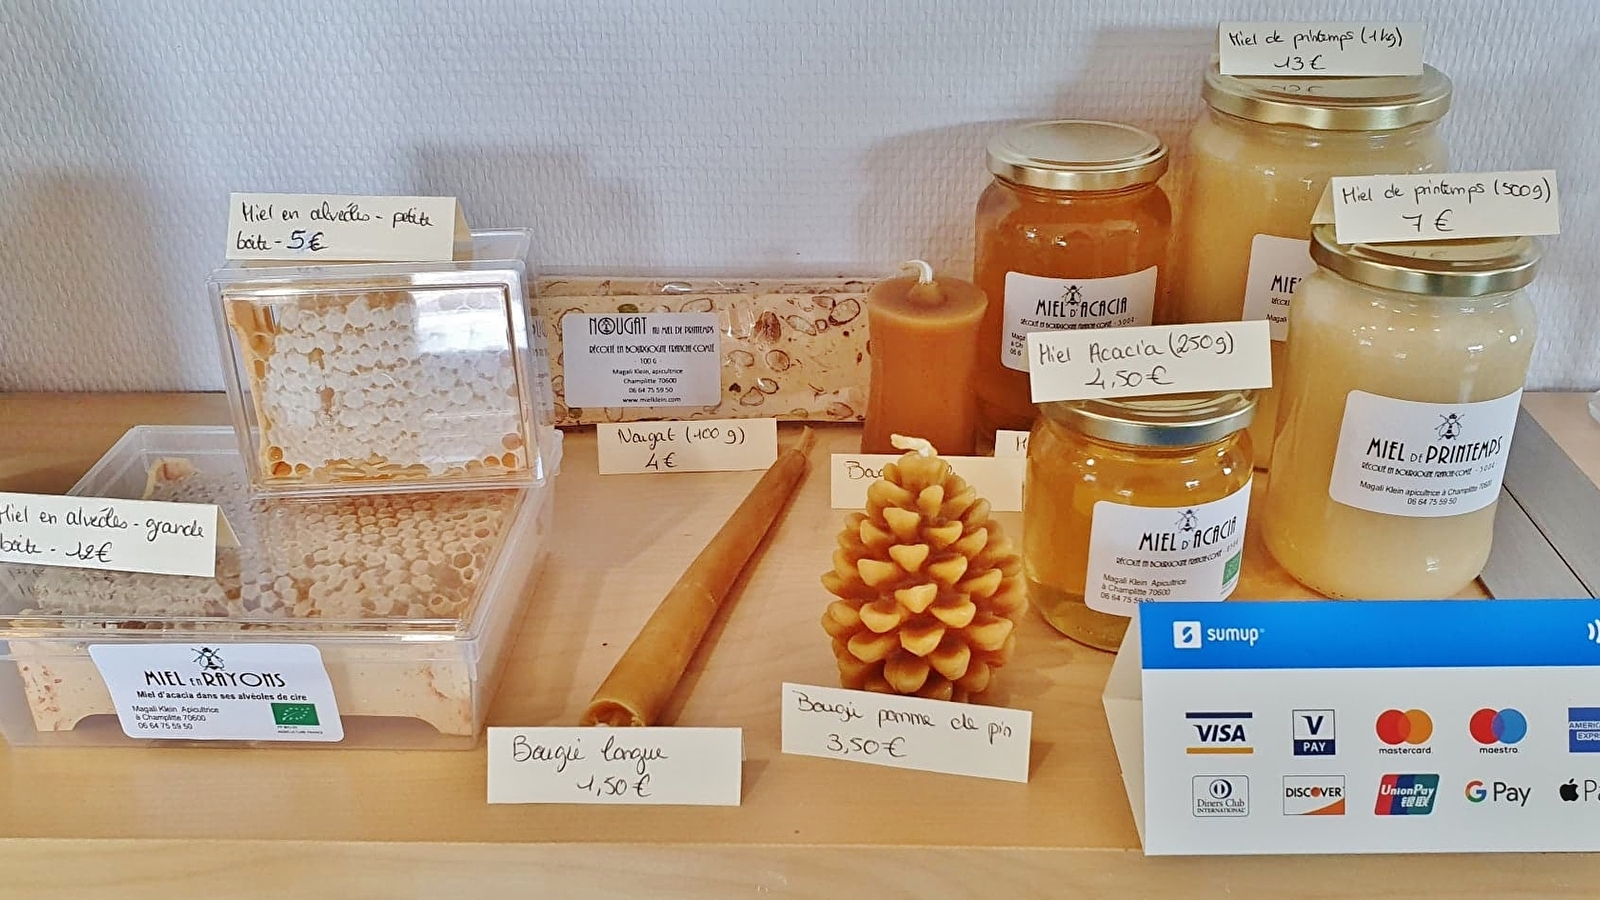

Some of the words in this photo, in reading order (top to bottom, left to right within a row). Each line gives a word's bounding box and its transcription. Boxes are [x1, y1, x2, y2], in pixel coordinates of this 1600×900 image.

[1229, 30, 1257, 47] Miel
[1265, 30, 1285, 44] de
[1294, 30, 1354, 51] printemps
[1342, 187, 1373, 204] Miel
[1384, 183, 1404, 198] de
[1414, 180, 1485, 205] printemps
[242, 202, 273, 222] Miel
[282, 209, 299, 221] en
[393, 207, 434, 228] petite
[1271, 275, 1302, 294] MIE
[1036, 299, 1066, 317] MIEL
[589, 317, 647, 335] NOUGAT
[662, 326, 673, 334] MIEL
[675, 326, 682, 334] DE
[684, 325, 714, 334] PRINTEMPS
[1039, 343, 1071, 365] Miel
[1089, 340, 1164, 364] Acacia
[618, 428, 676, 450] Nougat
[1366, 437, 1405, 462] MIEL
[1410, 452, 1423, 464] DE
[1425, 435, 1503, 464] PRINTEMPS
[1360, 480, 1384, 492] Magali
[1385, 486, 1404, 495] Klein
[1405, 489, 1440, 497] apicultrice
[1429, 497, 1438, 505] 75
[1439, 497, 1448, 505] 59
[1449, 497, 1458, 505] 50
[39, 512, 58, 524] en
[145, 518, 205, 542] grande
[1139, 532, 1177, 551] MIEL
[1103, 573, 1127, 585] Magali
[1129, 577, 1148, 586] Klein
[1151, 579, 1187, 587] Apicultrice
[1101, 592, 1110, 600] 06
[1108, 584, 1147, 596] Champlitte
[1207, 628, 1259, 647] sumup
[144, 670, 187, 687] MIEL
[203, 671, 287, 688] RAYONS
[137, 690, 155, 699] Miel
[158, 690, 194, 700] d'acacia
[196, 691, 218, 700] dans
[238, 691, 275, 701] alvéoles
[277, 692, 288, 701] de
[290, 693, 308, 701] cire
[132, 705, 158, 715] Magali
[158, 705, 177, 714] Klein
[181, 706, 220, 715] Apicultrice
[182, 723, 193, 731] 50
[951, 713, 979, 730] de
[988, 721, 1012, 745] pin
[1193, 724, 1246, 742] VISA
[1302, 715, 1324, 736] V
[1577, 732, 1600, 740] EXPR
[513, 735, 585, 773] Bougie
[602, 736, 668, 774] longue
[1303, 742, 1326, 752] PAY
[1379, 747, 1432, 755] mastercard
[1286, 787, 1342, 798] DISCOVER
[1381, 784, 1435, 799] UnionPay
[1493, 782, 1532, 807] Pay
[1197, 798, 1223, 807] Diners
[1225, 798, 1245, 807] Club
